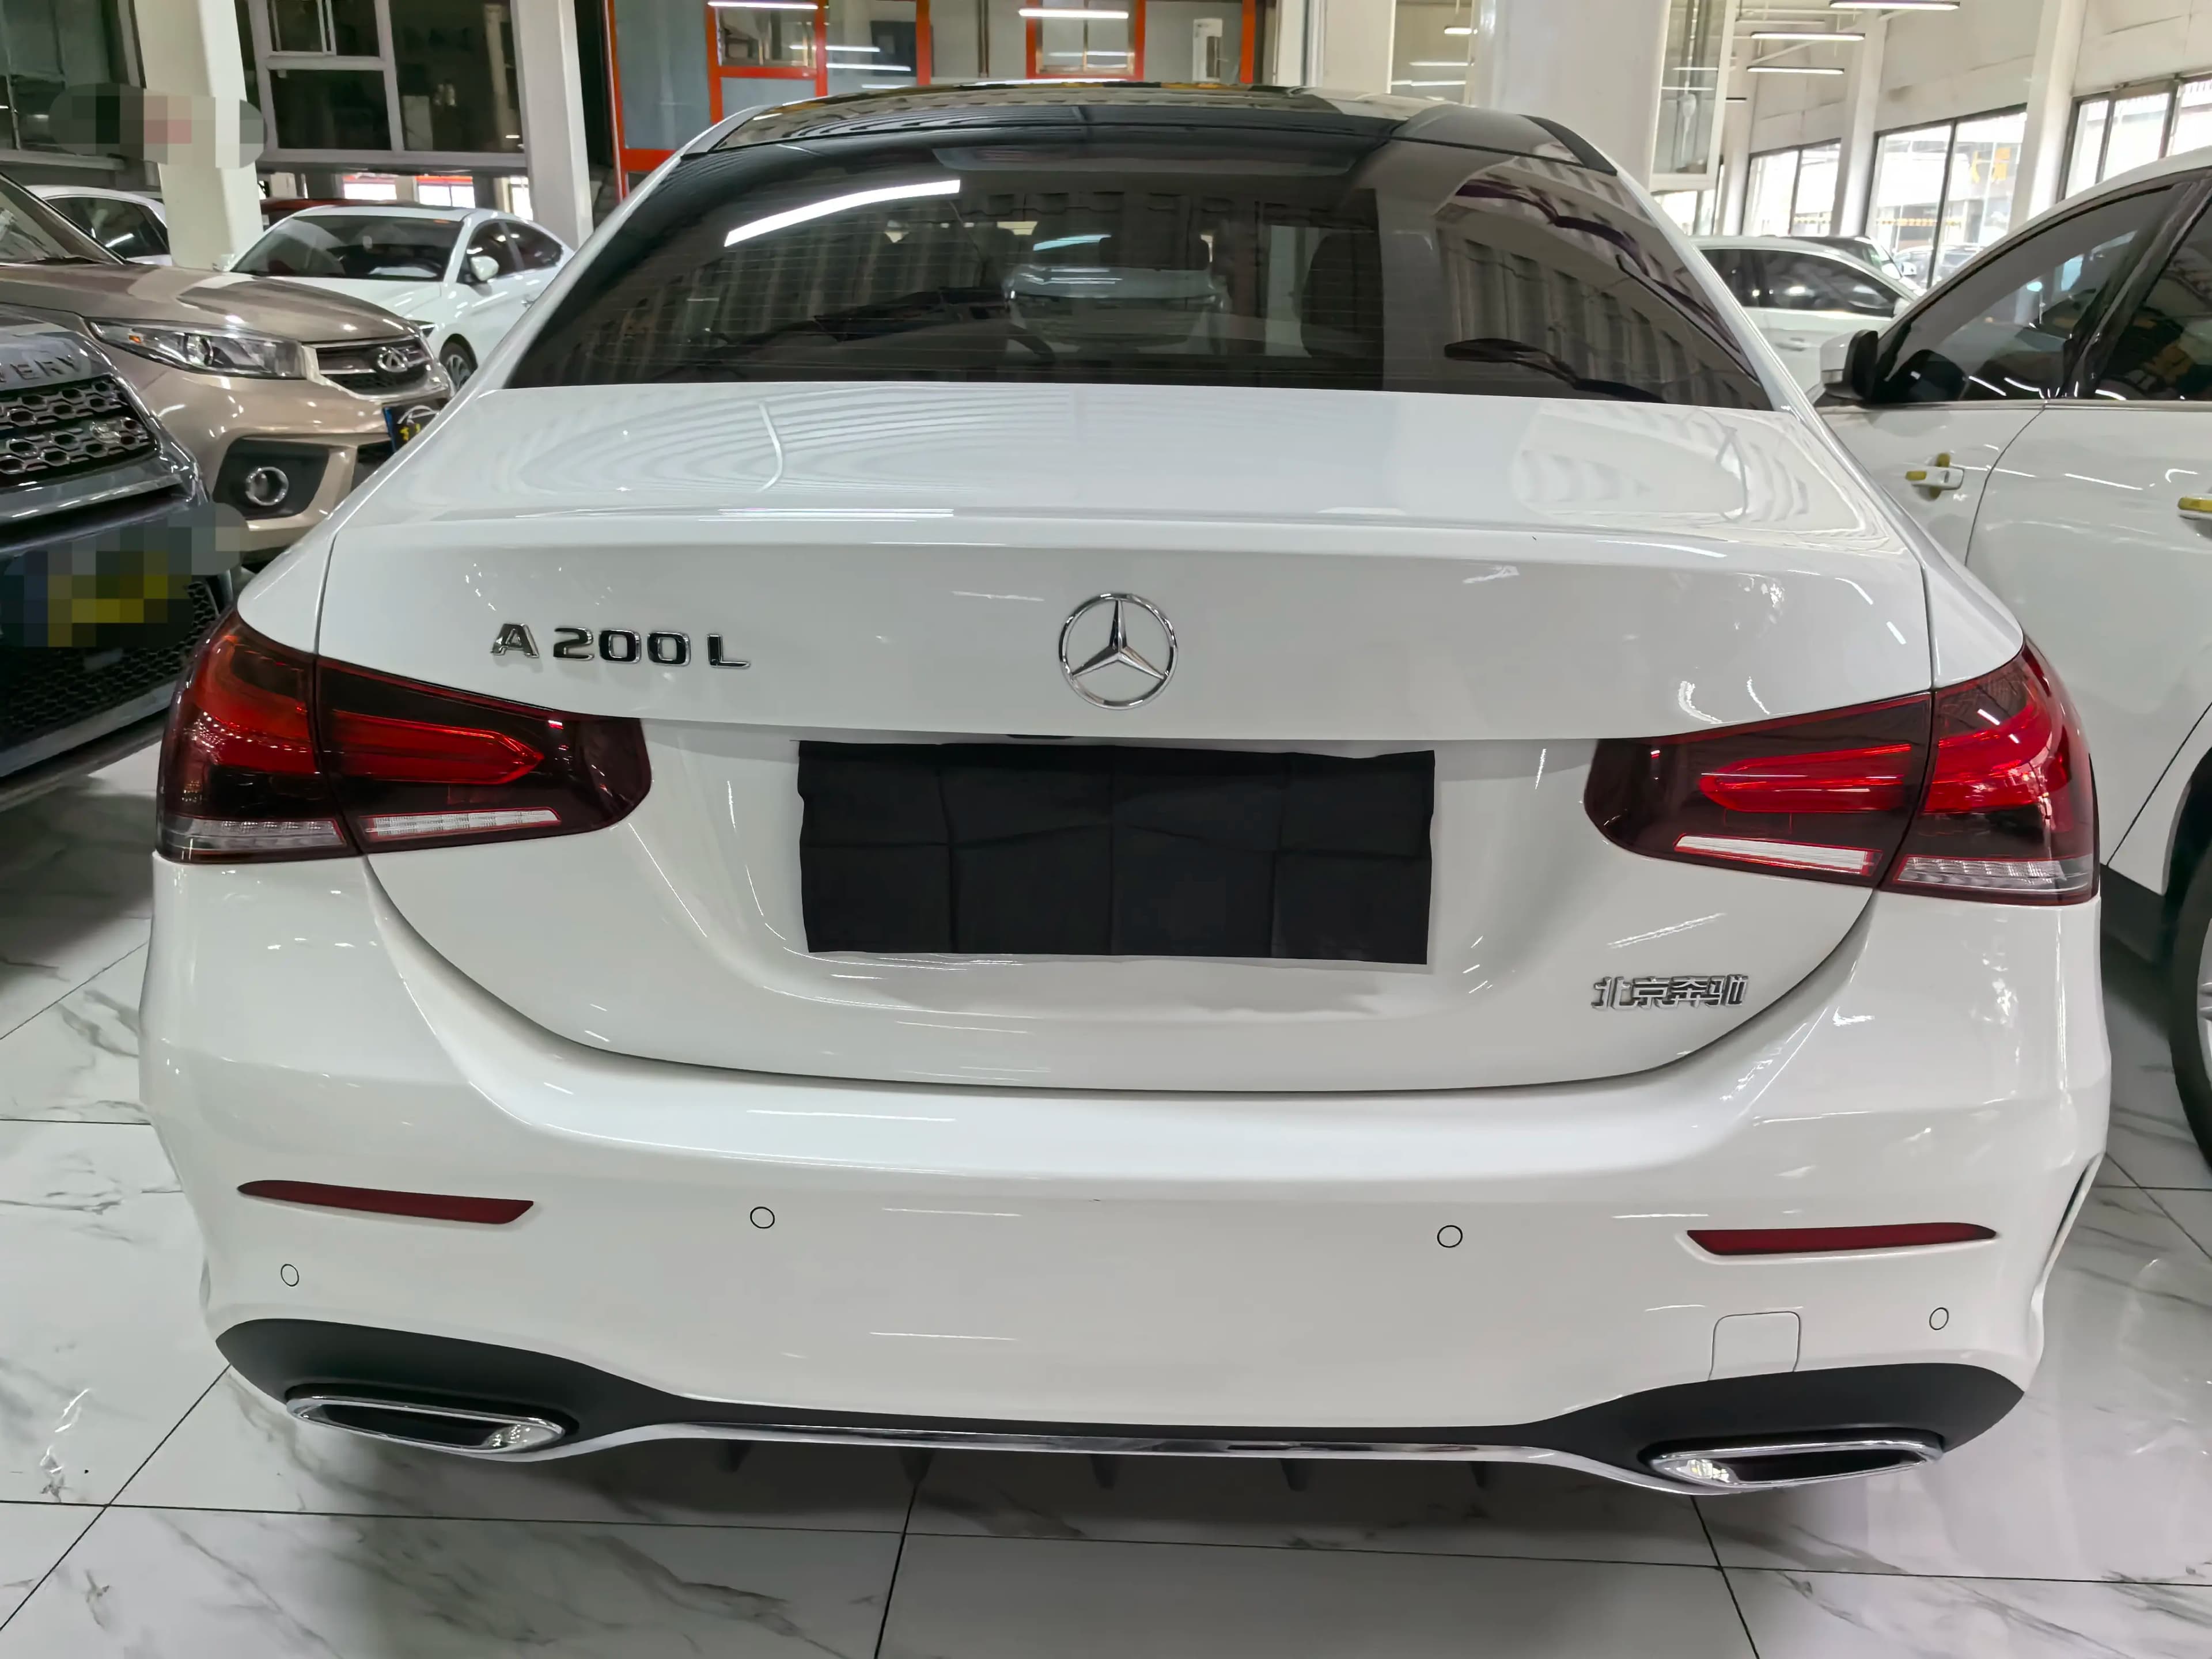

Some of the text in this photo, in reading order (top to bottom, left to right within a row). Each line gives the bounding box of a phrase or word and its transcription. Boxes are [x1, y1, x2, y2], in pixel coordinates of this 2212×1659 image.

[490, 622, 751, 669] A 200 L
[1590, 974, 1749, 1010] 北京奔驰
